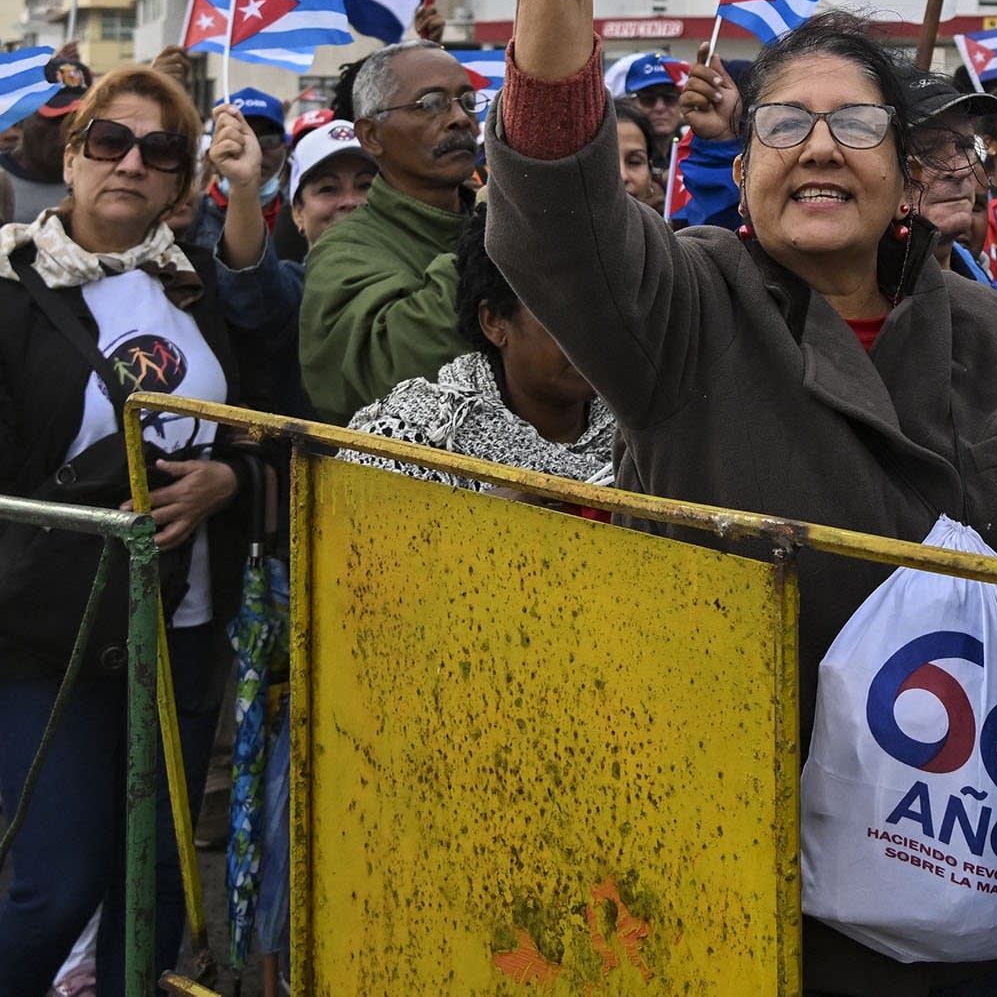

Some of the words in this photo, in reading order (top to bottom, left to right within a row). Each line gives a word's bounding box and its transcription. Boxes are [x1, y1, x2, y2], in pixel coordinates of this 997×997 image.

[867, 827, 958, 867] HACIENDO
[885, 847, 945, 878] SOBRE
[950, 872, 971, 889] LA
